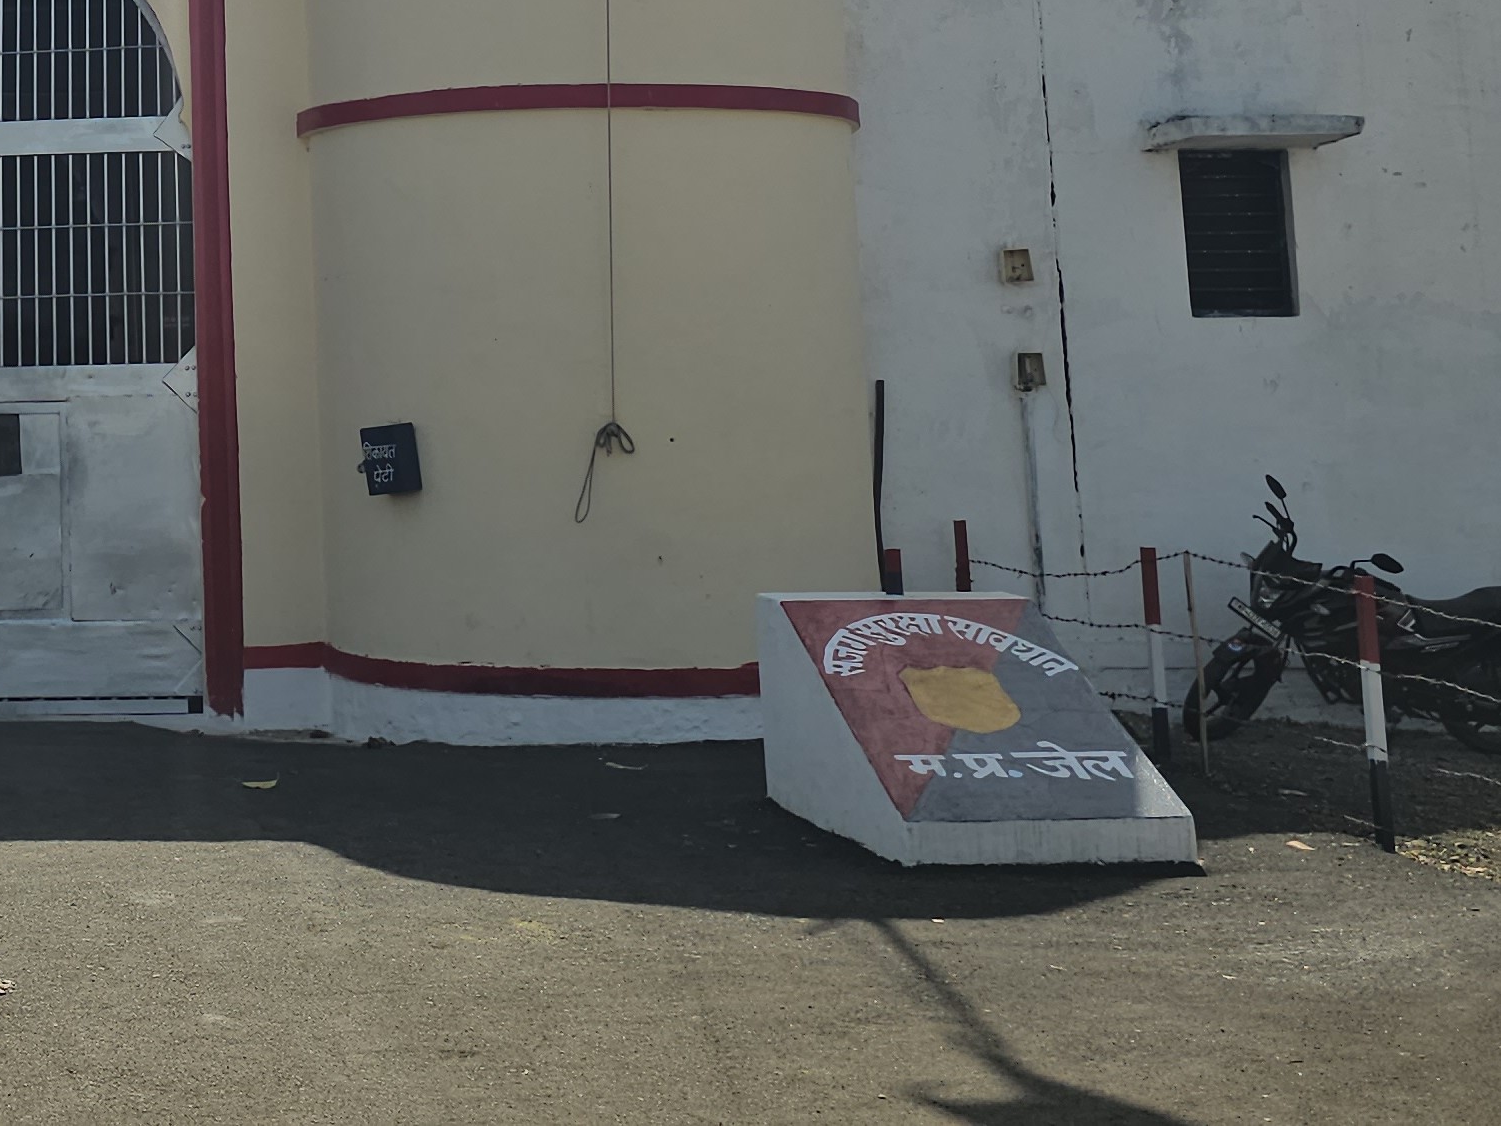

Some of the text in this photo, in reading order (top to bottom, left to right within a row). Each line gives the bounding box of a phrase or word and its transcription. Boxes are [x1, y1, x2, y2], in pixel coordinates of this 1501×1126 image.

[373, 463, 395, 483] पेटी
[823, 612, 1079, 676] सजग सुरक्षा सावधान
[1009, 740, 1135, 781] जेल
